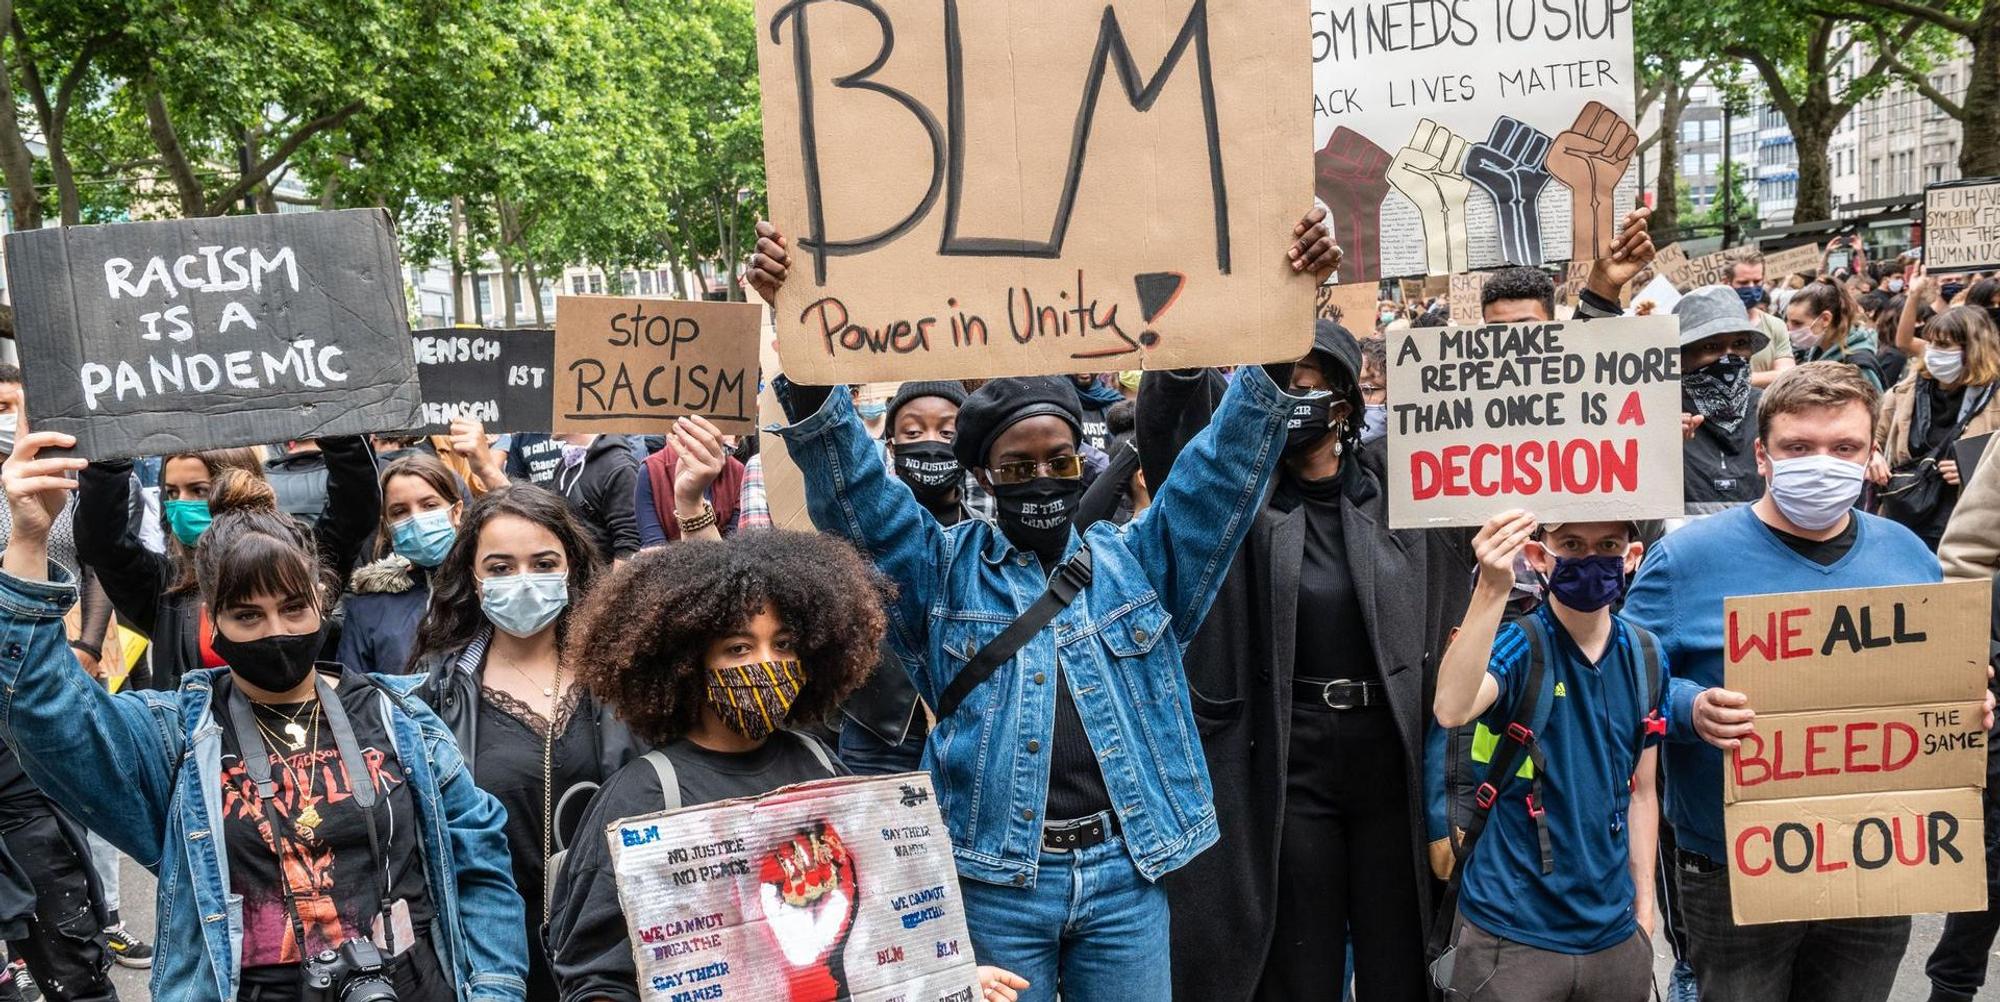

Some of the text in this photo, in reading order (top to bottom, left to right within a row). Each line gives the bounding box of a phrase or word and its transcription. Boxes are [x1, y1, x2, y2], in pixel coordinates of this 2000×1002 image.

[1367, 0, 1477, 54] NEEDS
[1389, 75, 1475, 108] LIVES
[1499, 60, 1618, 97] MATTER
[771, 0, 1232, 286] BLM
[1929, 192, 1946, 207] IF
[1928, 245, 1977, 265] HUMAN
[104, 245, 299, 299] RACISM
[139, 302, 257, 342] IS A
[801, 297, 936, 357] Power
[947, 298, 988, 347] in
[1396, 323, 1564, 366] A MISTAKE
[80, 339, 348, 410] PANDEMIC
[508, 365, 545, 388] IST
[1421, 347, 1681, 393] REPEATED MORE
[569, 358, 746, 419] RACISM
[1393, 390, 1646, 435] THAN ONCE IS A
[905, 458, 959, 471] NO JUSTICE
[1411, 438, 1638, 500] DECISION
[1021, 499, 1065, 514] BE THE
[1729, 602, 1927, 663] WE ALL
[1919, 710, 1961, 728] THE
[1732, 722, 1919, 786] BLEED
[1924, 731, 1985, 754] SAME
[621, 825, 661, 847] BLM
[667, 838, 746, 865] NO JUSTICE
[1735, 811, 1963, 877] COLOUR
[673, 857, 750, 886] NO PEACE
[908, 886, 945, 906] CANNOT
[639, 912, 724, 943] WE CANNOT
[652, 934, 722, 961] BREATHE
[876, 940, 959, 966] BLM BLM
[686, 961, 730, 983] THEIR
[670, 984, 723, 1002] NAMES
